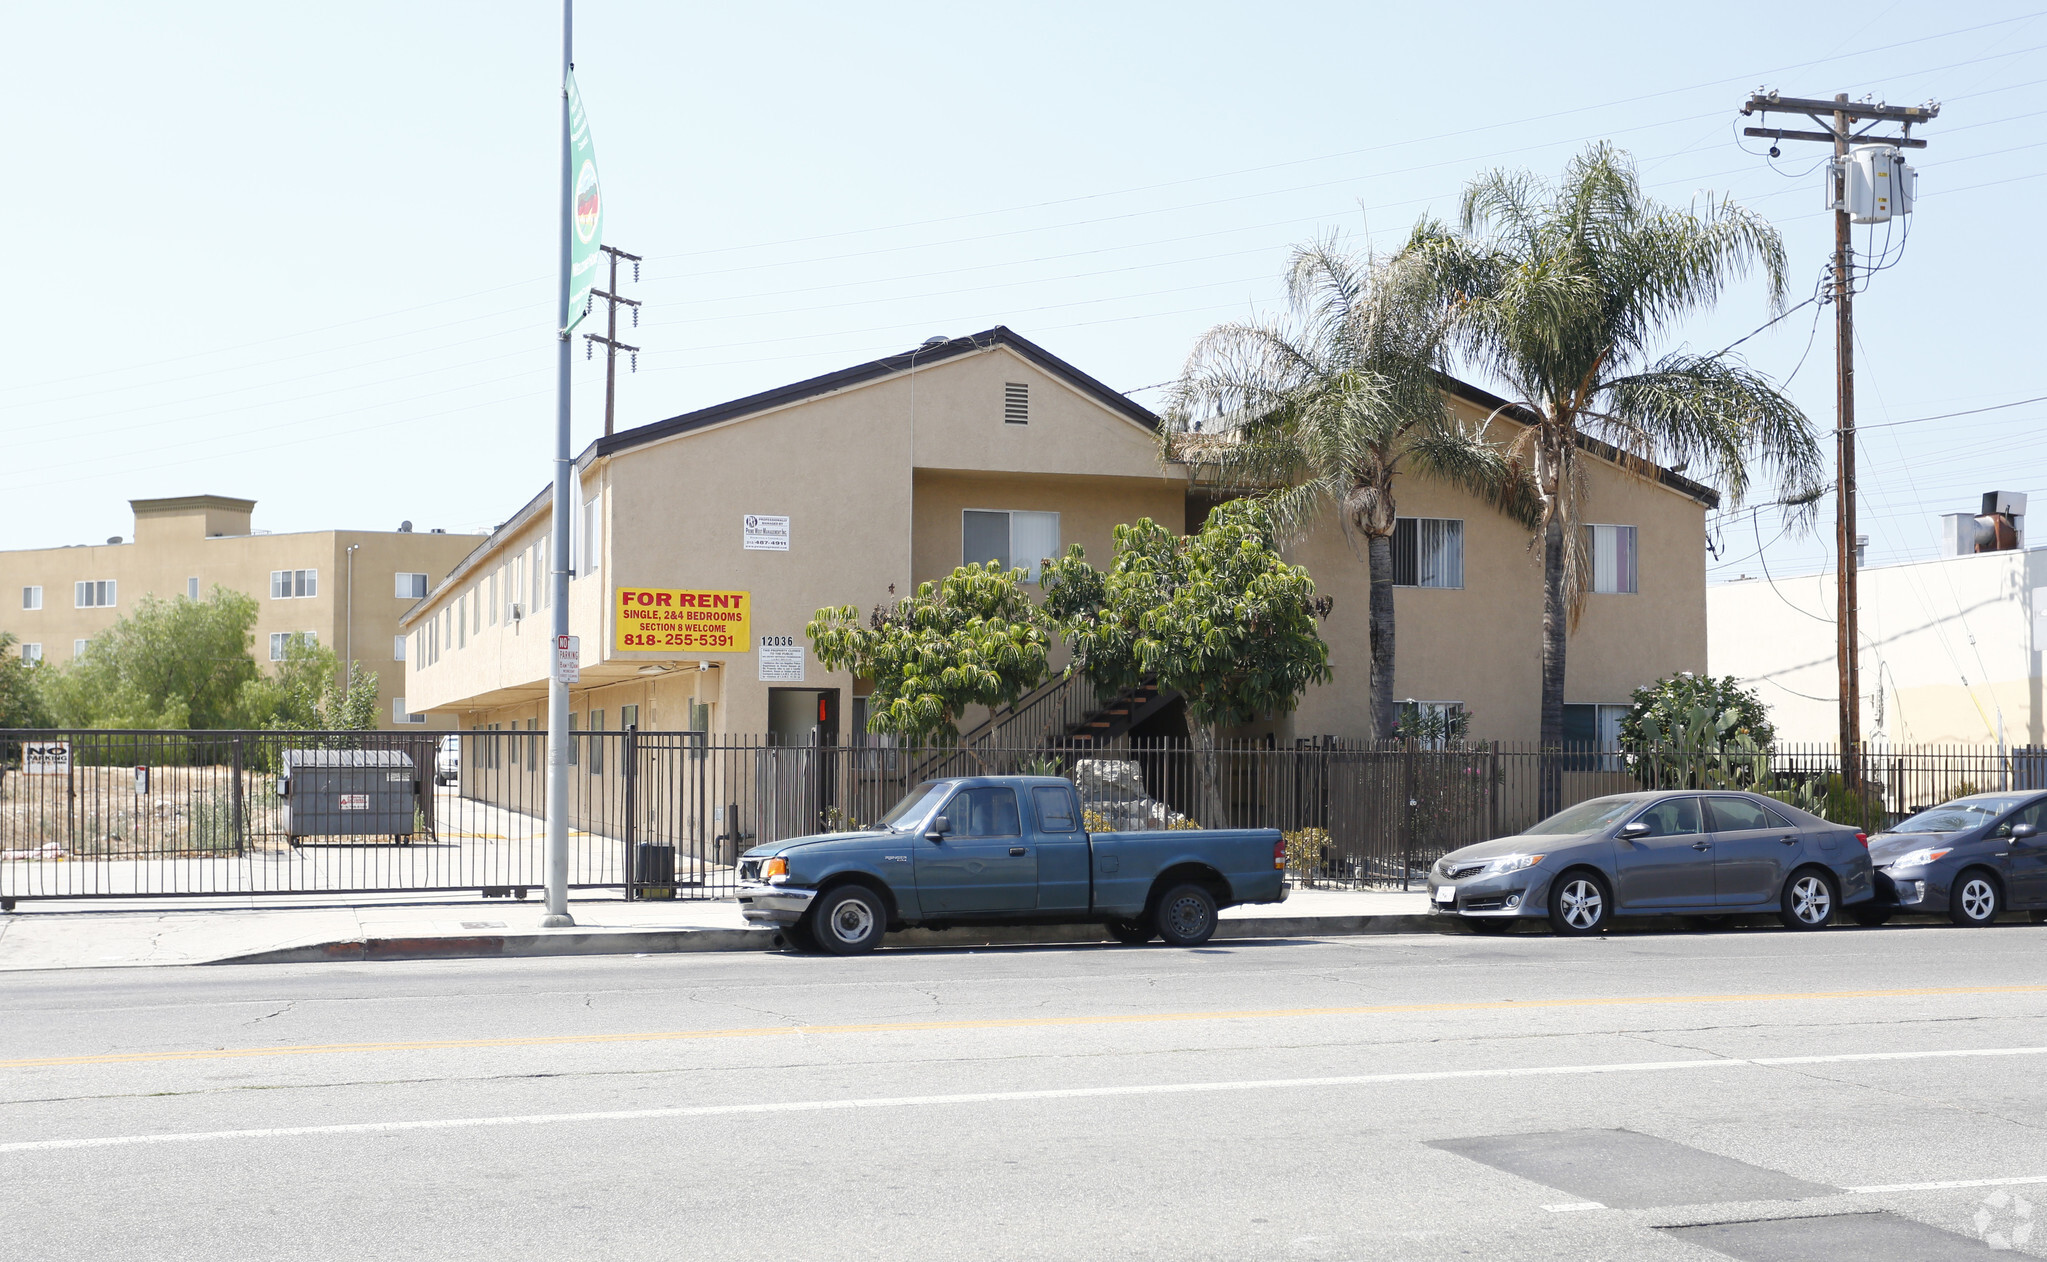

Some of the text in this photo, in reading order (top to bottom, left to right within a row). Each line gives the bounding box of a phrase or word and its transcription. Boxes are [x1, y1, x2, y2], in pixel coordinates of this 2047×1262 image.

[622, 592, 743, 608] FOR RENT
[623, 609, 743, 622] SINGLE, 2&4 BEDROOMS
[639, 622, 727, 633] SECTION 8 WELCOME
[560, 637, 568, 648] NO
[762, 636, 793, 647] 12036
[559, 650, 579, 660] PARKING
[27, 747, 67, 755] NO
